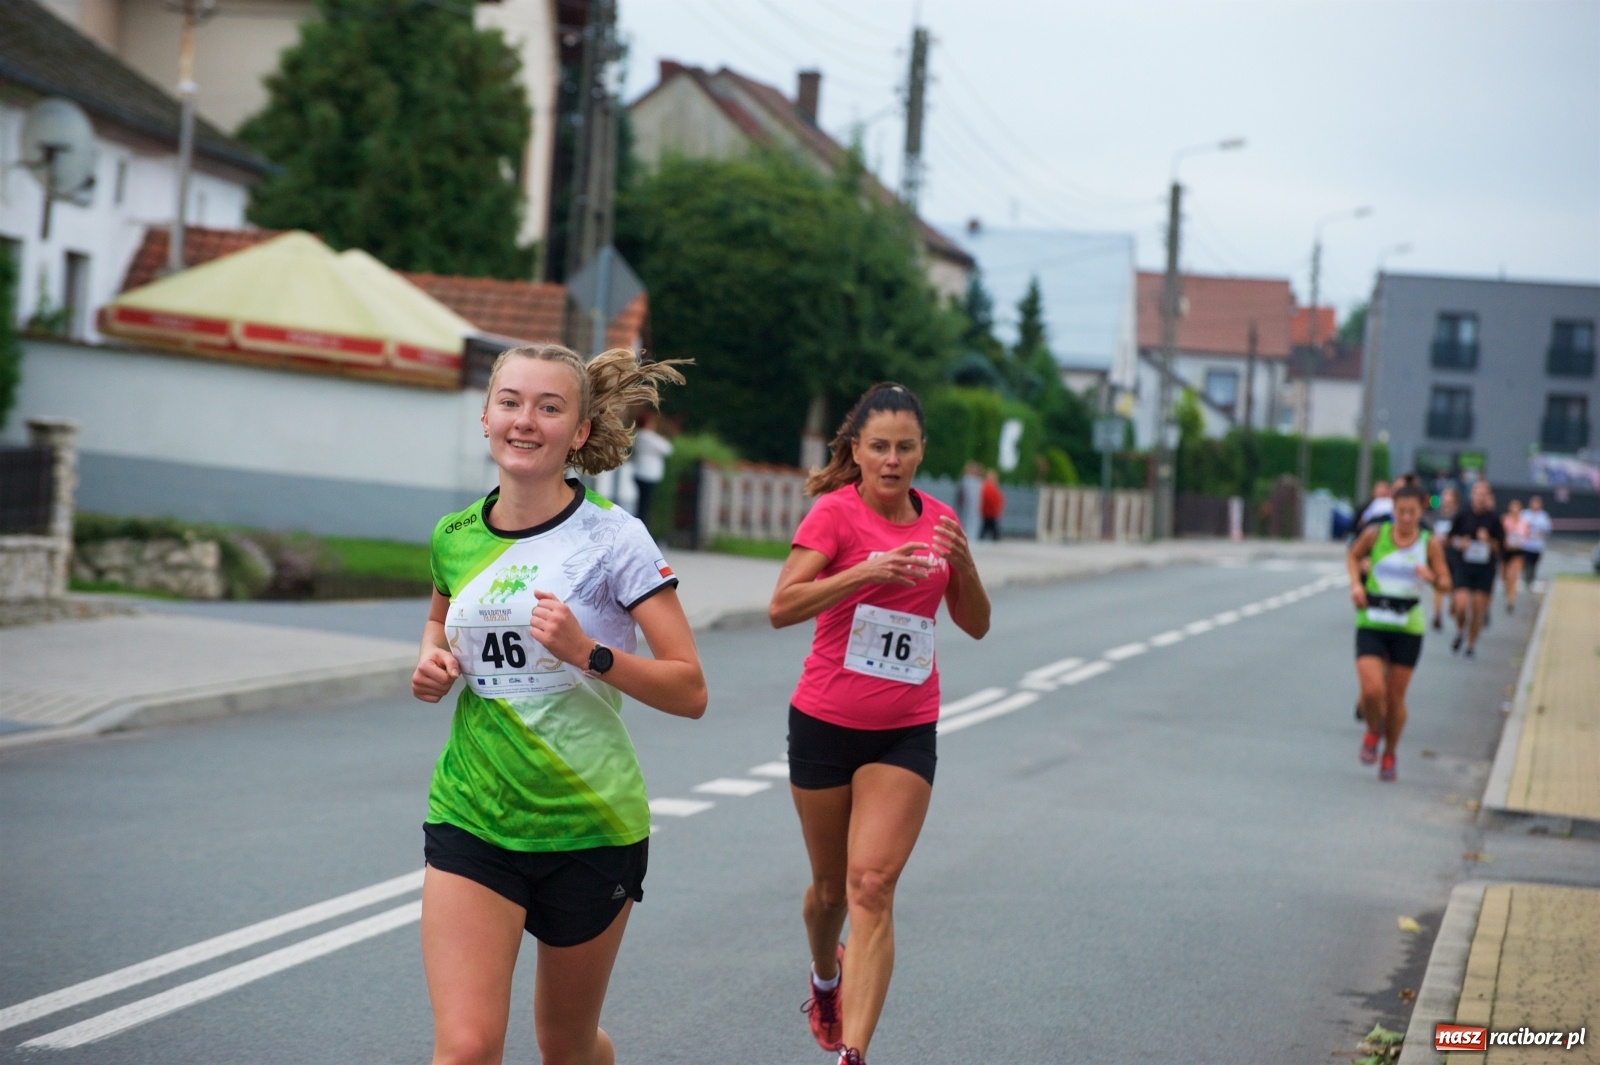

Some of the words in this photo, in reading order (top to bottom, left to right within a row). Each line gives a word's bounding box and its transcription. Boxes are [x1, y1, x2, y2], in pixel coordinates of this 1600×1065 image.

[445, 514, 477, 534] deep
[481, 631, 526, 669] 46
[881, 631, 911, 661] 16
